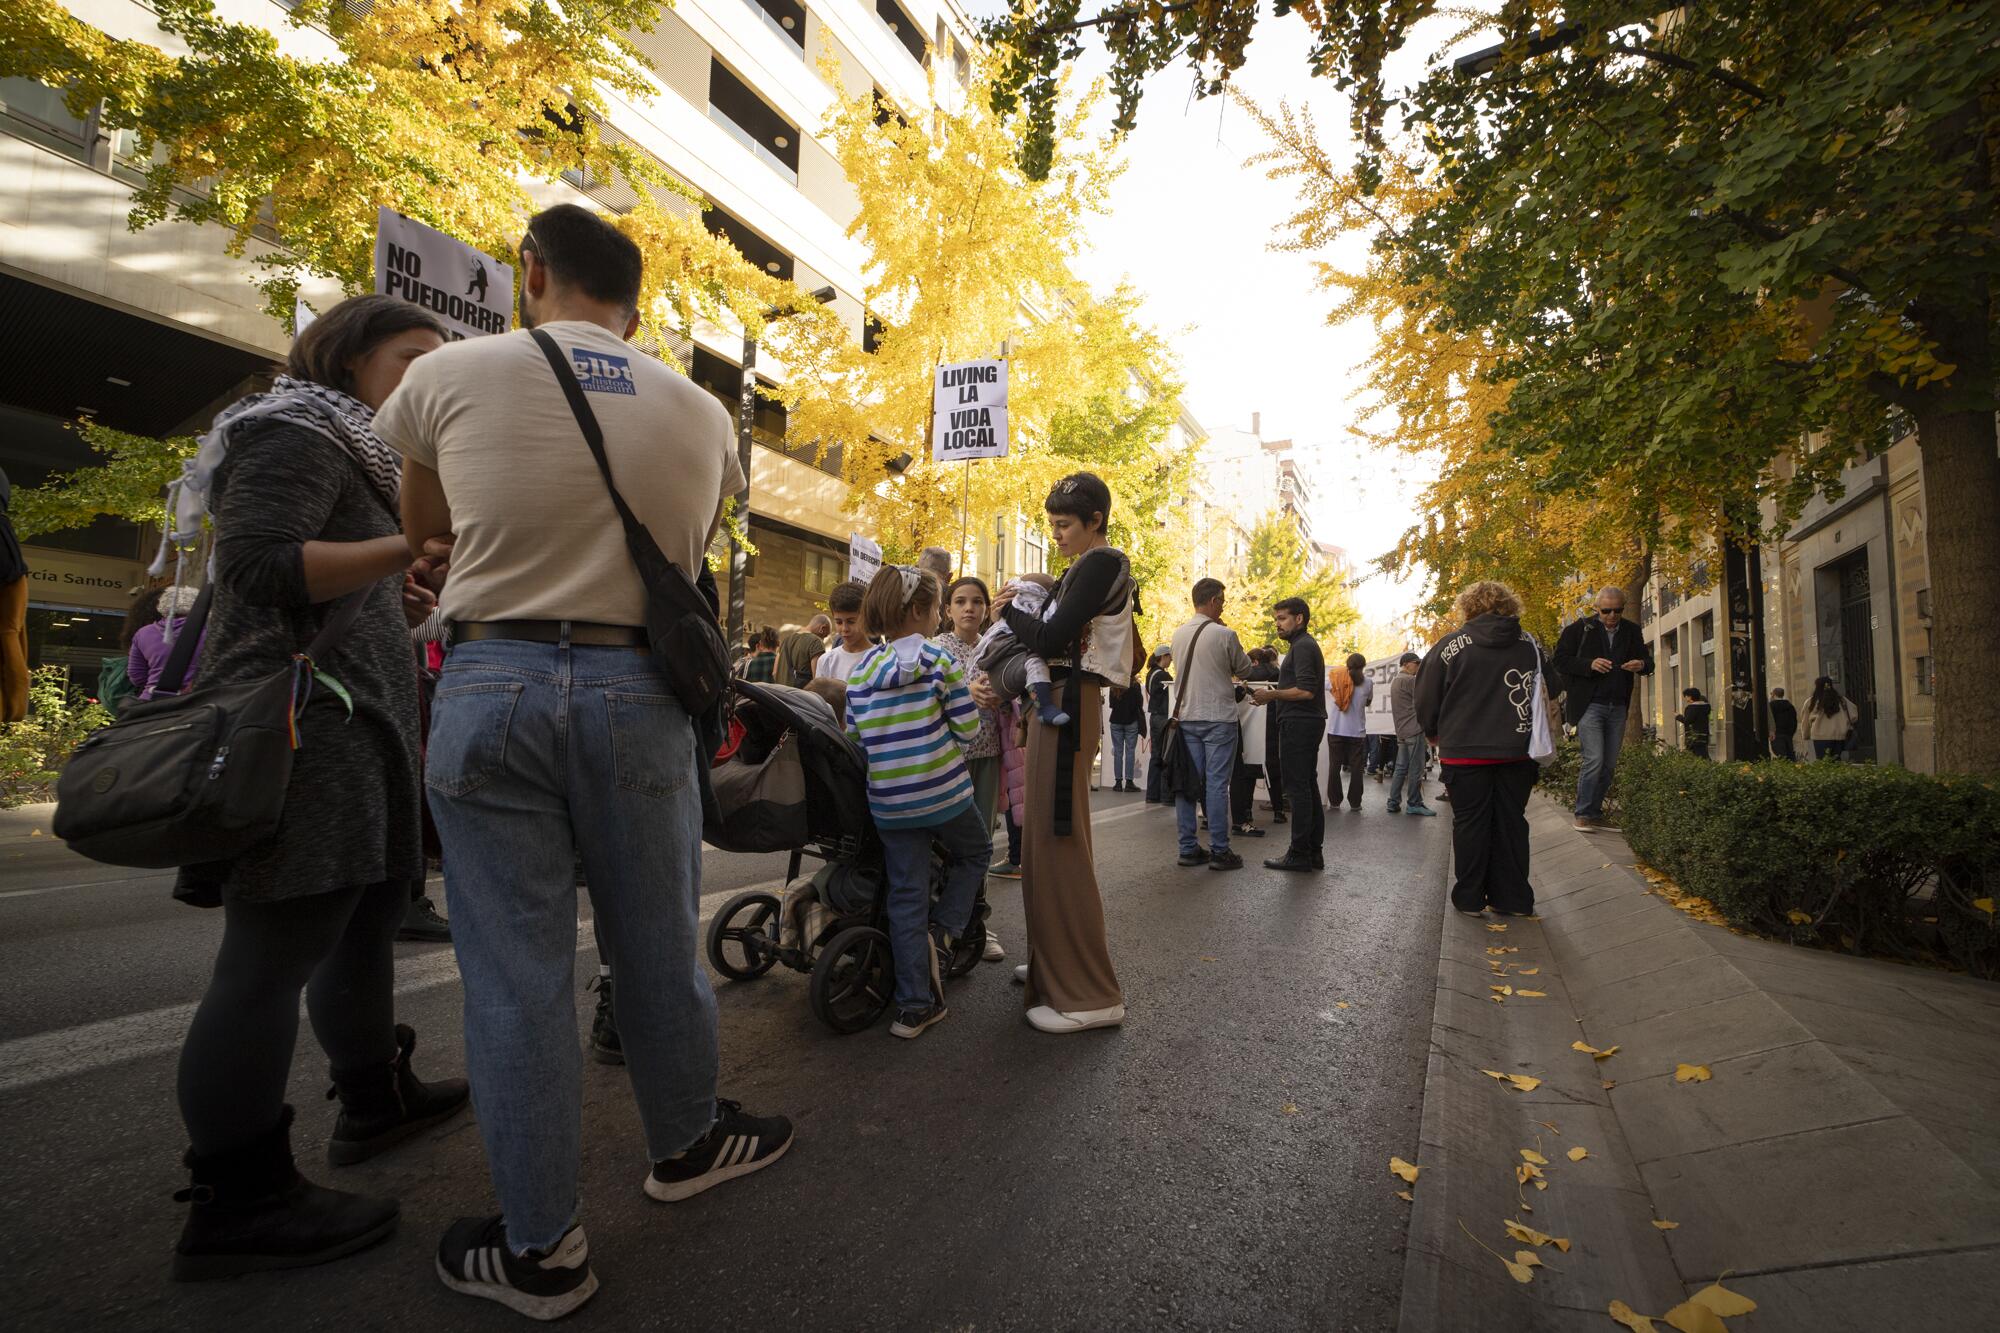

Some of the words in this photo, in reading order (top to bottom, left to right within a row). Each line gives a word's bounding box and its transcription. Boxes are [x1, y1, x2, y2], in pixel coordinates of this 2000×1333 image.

[387, 242, 421, 278] NO
[385, 269, 506, 335] PUEDORRR
[592, 376, 632, 388] history
[942, 366, 998, 388] LIVING
[580, 382, 635, 395] museum
[959, 385, 979, 404] LA
[950, 408, 991, 430] VIDA
[943, 428, 997, 450] LOCAL
[26, 569, 57, 582] rcía
[64, 573, 123, 589] Santos
